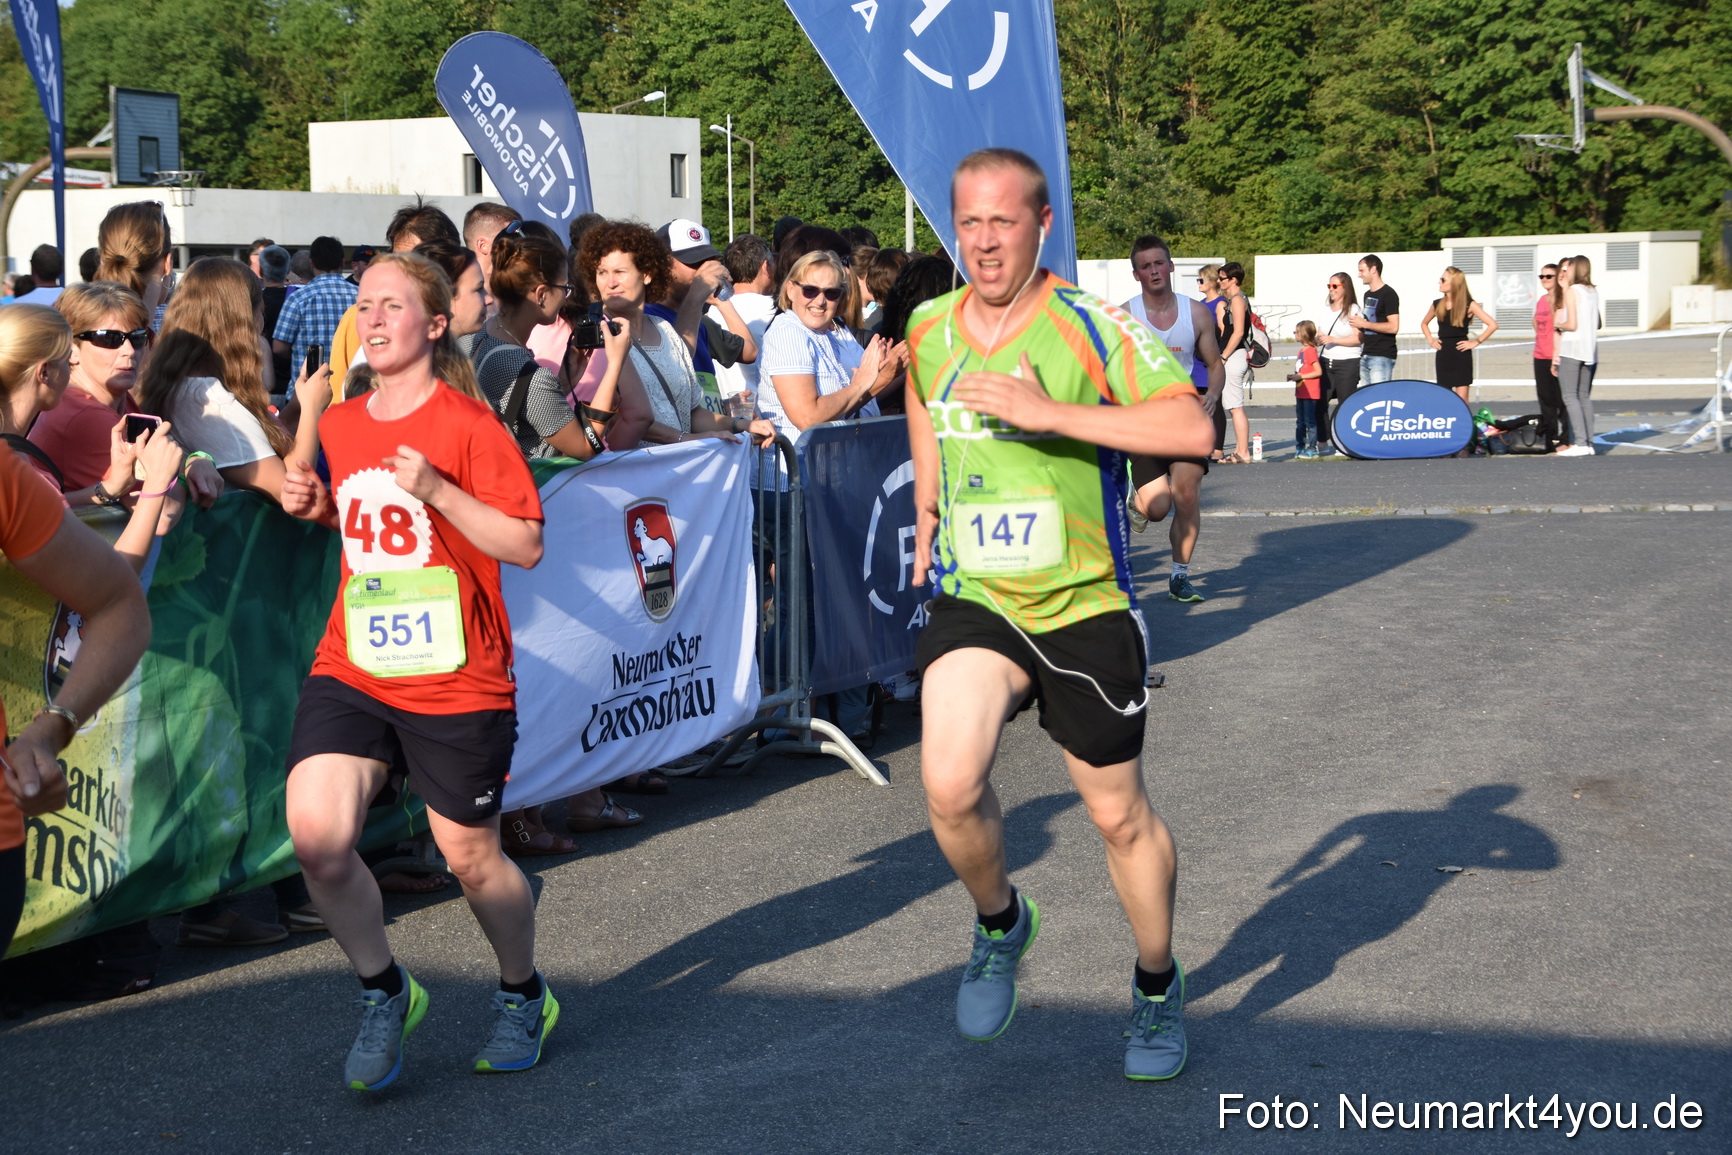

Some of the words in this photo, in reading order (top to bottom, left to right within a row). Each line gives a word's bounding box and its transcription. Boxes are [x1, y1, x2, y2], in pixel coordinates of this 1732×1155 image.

[1371, 411, 1457, 433] Fischer
[585, 426, 601, 449] SONY
[1380, 431, 1452, 441] AUTOMOBILE
[344, 497, 418, 556] 48
[970, 512, 1038, 547] 147
[650, 591, 669, 611] 1628
[368, 611, 433, 648] 551
